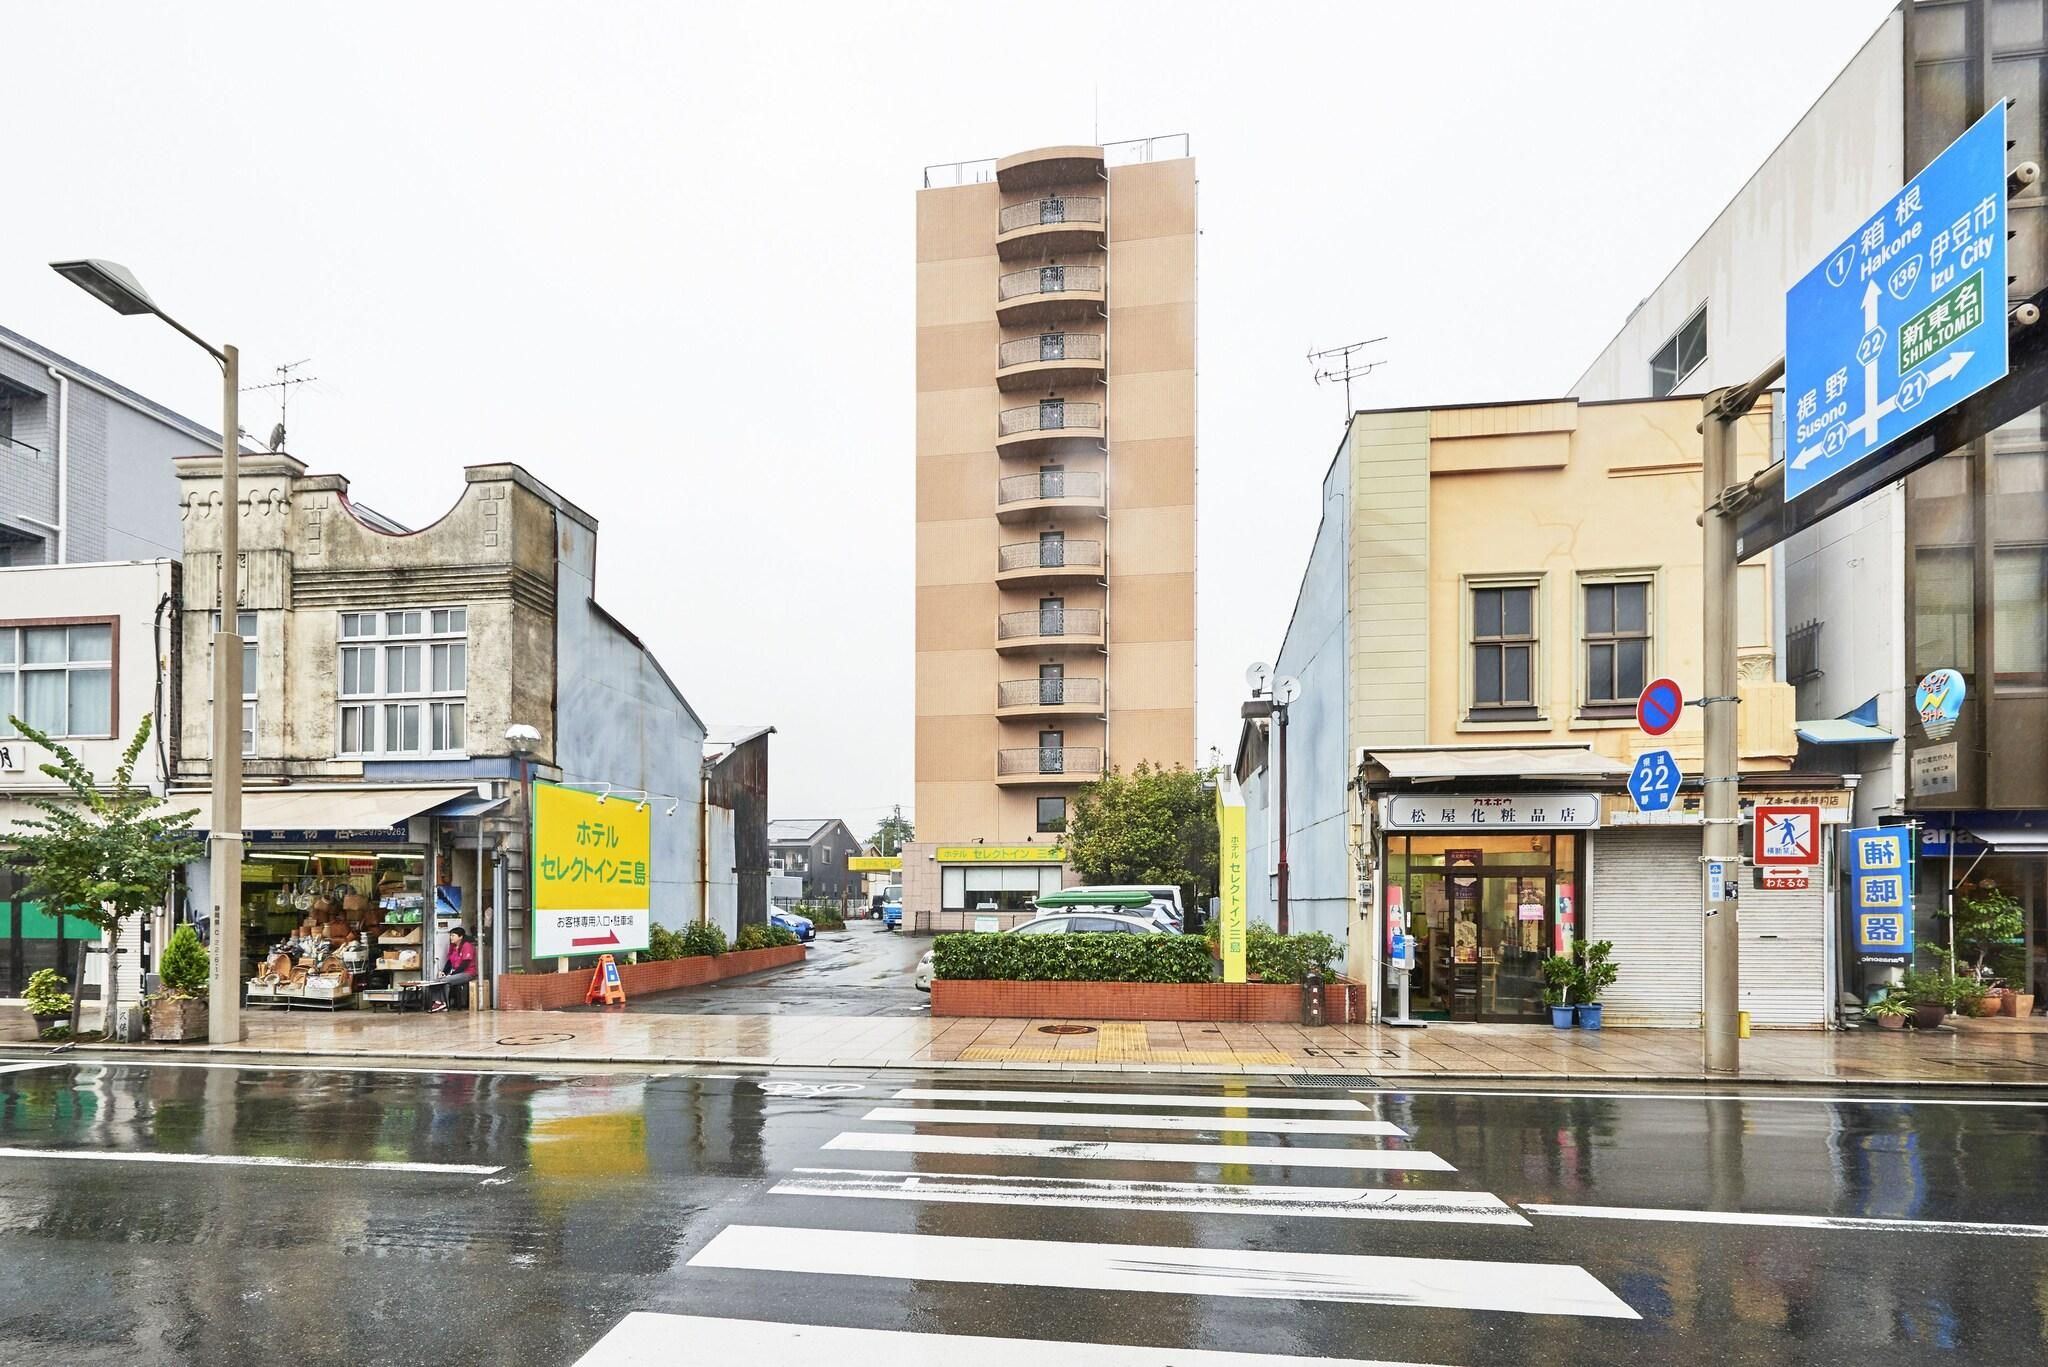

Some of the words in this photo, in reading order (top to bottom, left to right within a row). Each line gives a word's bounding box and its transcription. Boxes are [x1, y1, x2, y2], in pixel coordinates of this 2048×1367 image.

[1860, 184, 1923, 256] 箱根
[1928, 193, 1997, 269] 伊豆市
[1860, 221, 1922, 281] Hakone
[1931, 263, 1954, 293] Izu
[1960, 234, 1994, 270] City
[1836, 257, 1844, 275] 1
[1892, 262, 1917, 291] 136
[1902, 283, 1977, 350] 新東名
[1862, 333, 1881, 357] 22
[1903, 306, 1979, 369] SHIN-TOMEI
[1797, 366, 1848, 423] 裾野
[1903, 377, 1923, 406] 21
[1797, 402, 1847, 444] Susono
[1827, 431, 1844, 453] 21
[1920, 674, 1950, 690] KOH
[1921, 711, 1945, 723] SHA
[1640, 765, 1669, 792] 22
[1411, 807, 1575, 823] 松屋化粧品店
[576, 820, 619, 849] ホテル
[1231, 836, 1239, 860] ホテル
[943, 849, 967, 858] ホテル
[973, 849, 1029, 859] セレクトイン
[1767, 847, 1797, 856] 横断禁止
[541, 853, 647, 887] セレクトイン三島
[1766, 878, 1806, 888] わたるな
[557, 915, 634, 929] お客様専用入口・駐車場
[1229, 863, 1241, 953] セレクトイン三島
